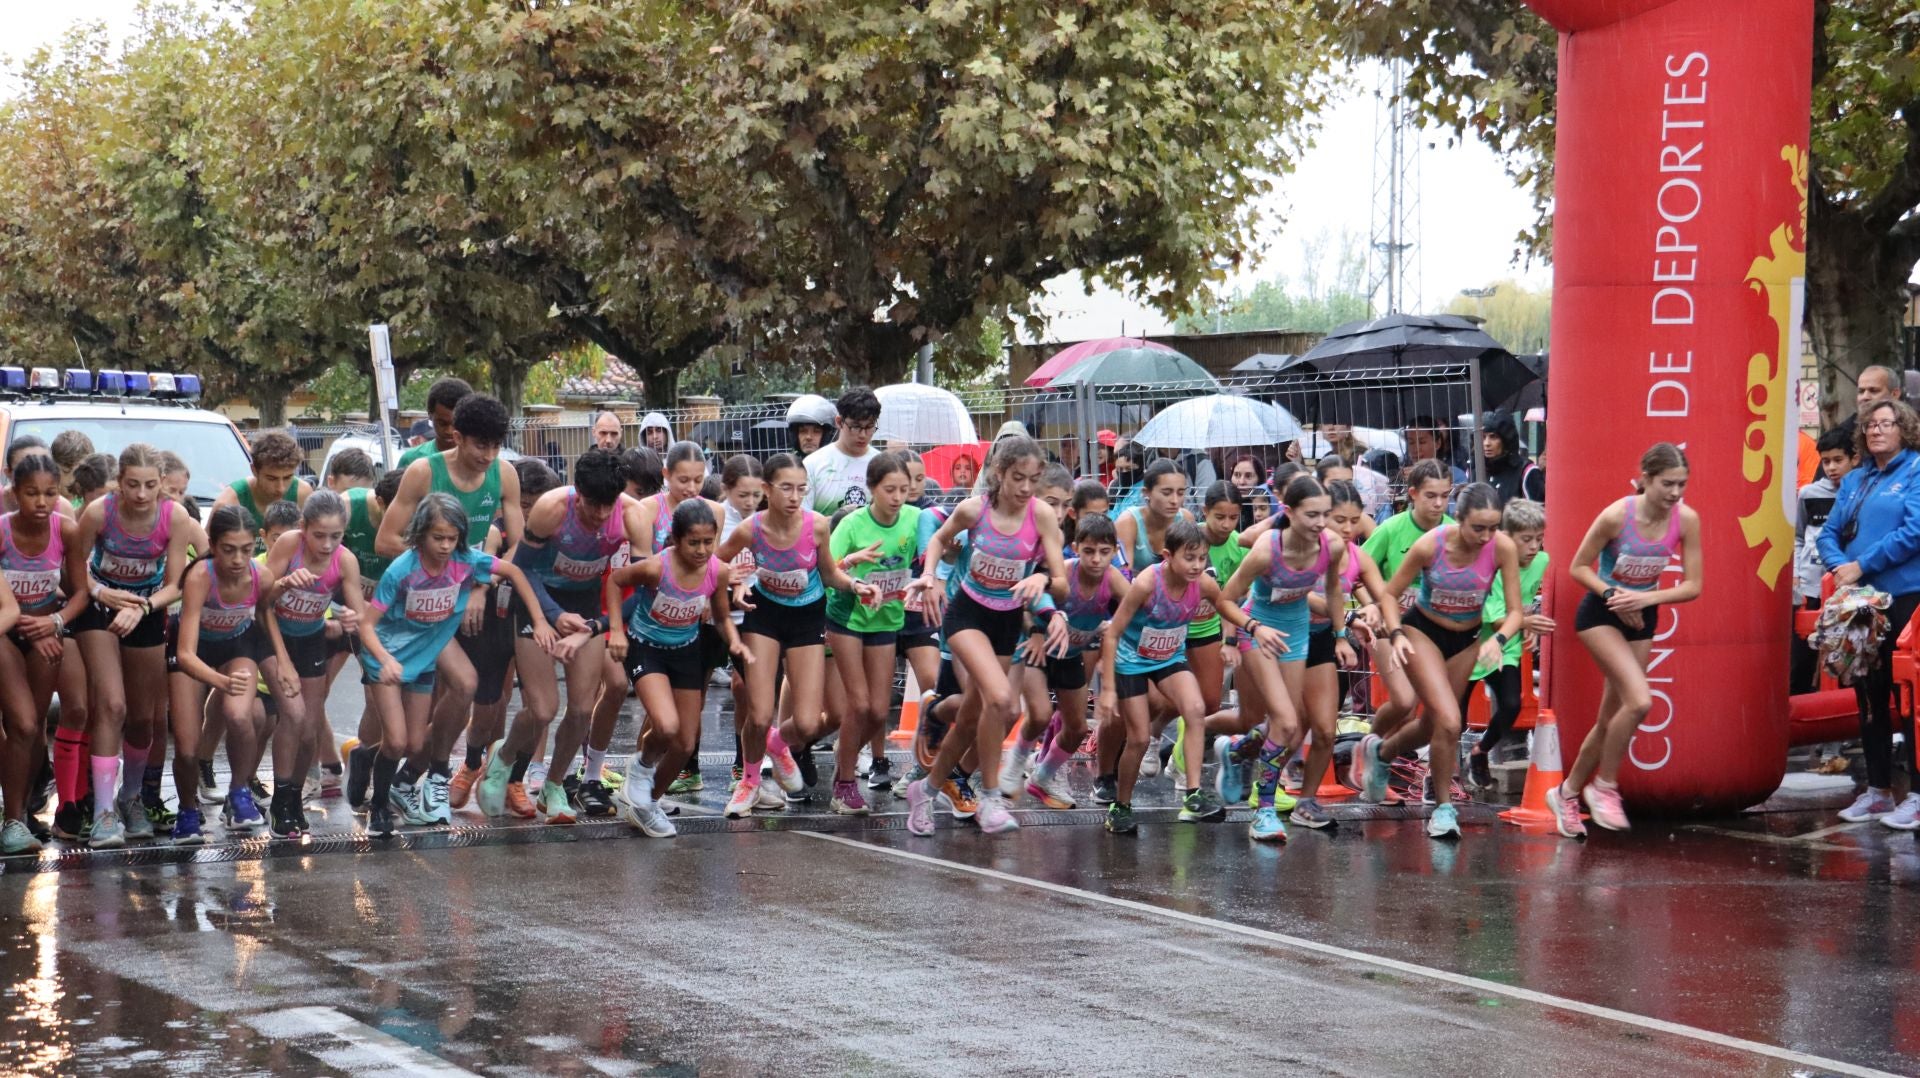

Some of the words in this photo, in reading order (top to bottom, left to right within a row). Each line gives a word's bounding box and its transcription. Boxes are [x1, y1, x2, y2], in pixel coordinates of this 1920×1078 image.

[1651, 51, 1709, 325] DEPORTES
[1646, 351, 1692, 416] DE
[978, 560, 1016, 580] 2053
[11, 580, 50, 595] 2042
[416, 594, 452, 611] 2045
[660, 603, 697, 619] 2038
